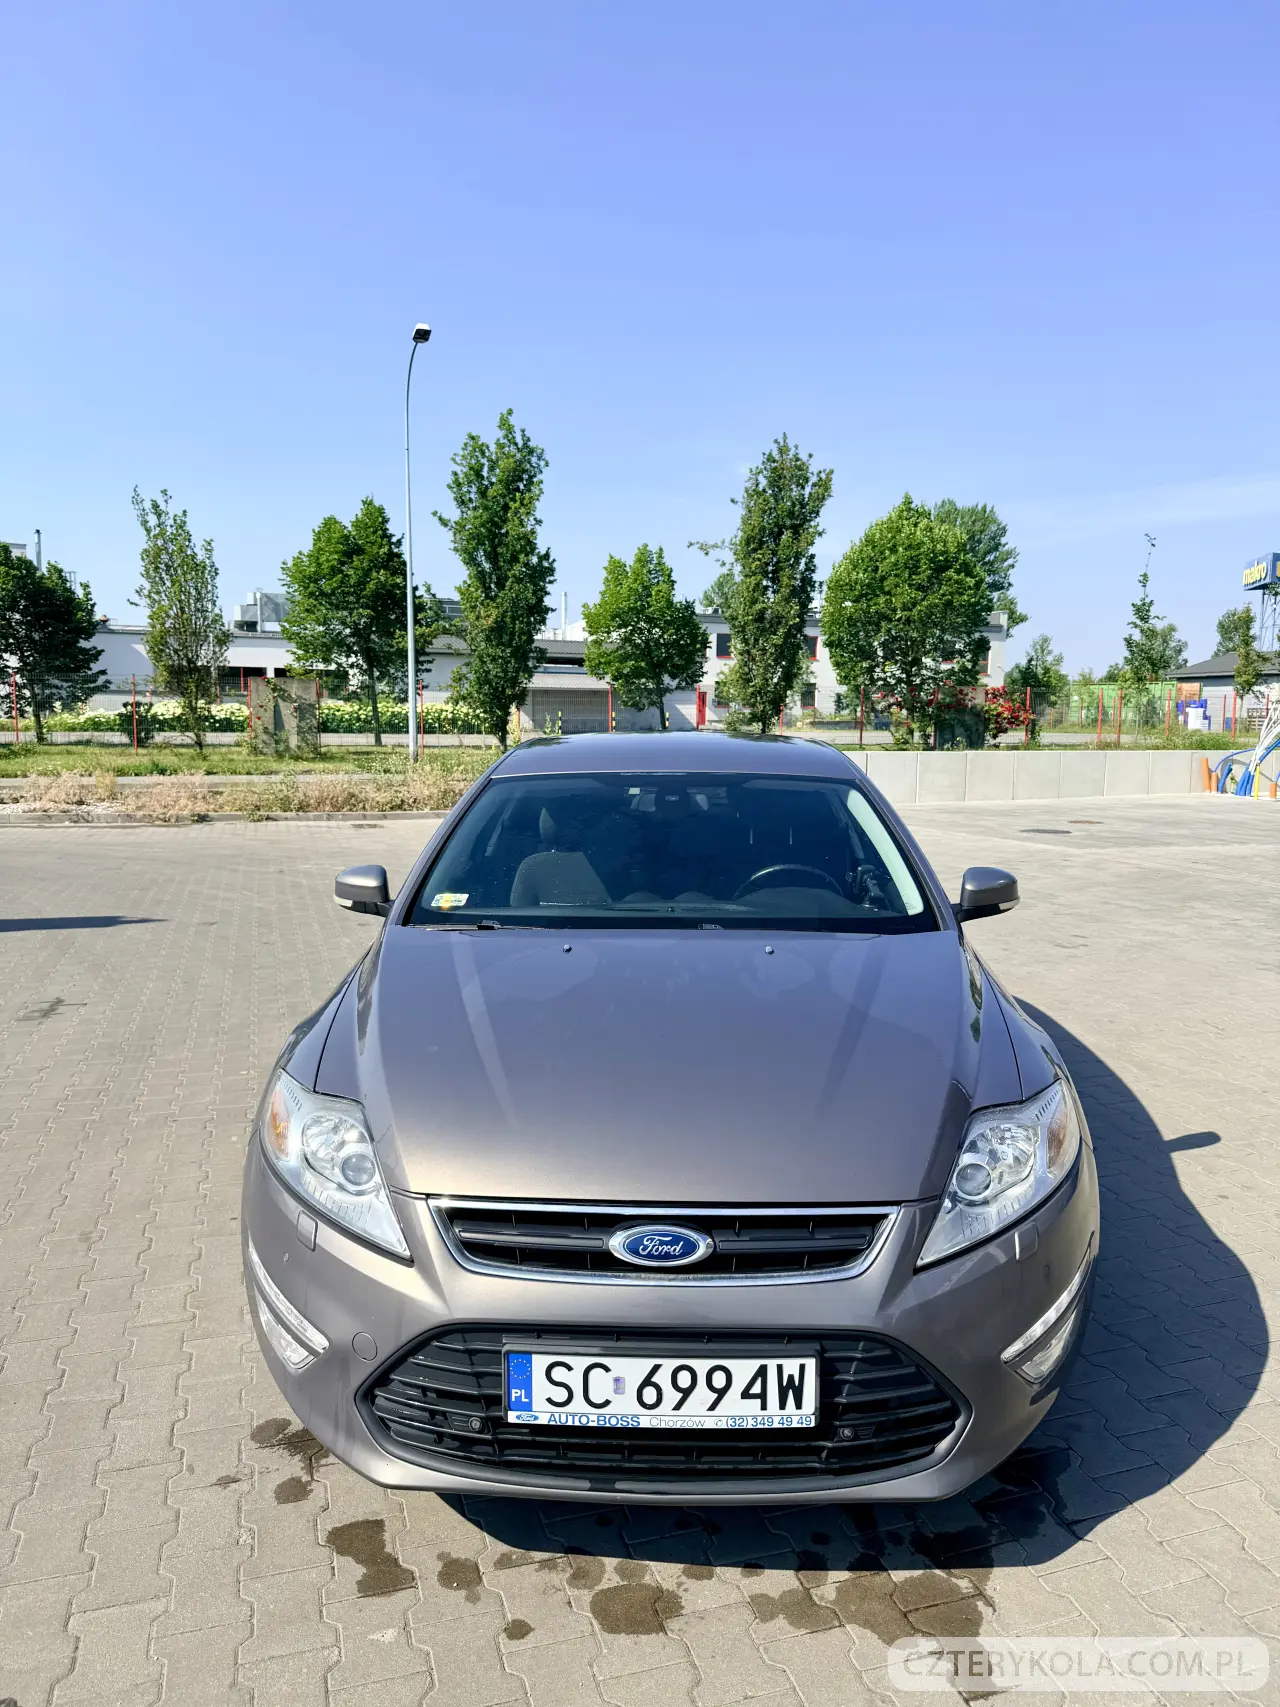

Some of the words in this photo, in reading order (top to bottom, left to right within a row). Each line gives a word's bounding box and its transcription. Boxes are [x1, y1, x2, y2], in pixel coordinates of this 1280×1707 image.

[1243, 560, 1267, 585] makro
[639, 1235, 683, 1256] Ford
[511, 1389, 529, 1402] PL
[545, 1360, 612, 1410] SC
[636, 1363, 806, 1412] 6994W
[547, 1413, 641, 1427] AUTO-BOSS
[649, 1416, 706, 1428] Chorzów
[725, 1416, 749, 1428] (32)
[751, 1416, 774, 1428] 349
[777, 1416, 793, 1427] 49
[797, 1415, 812, 1427] 49
